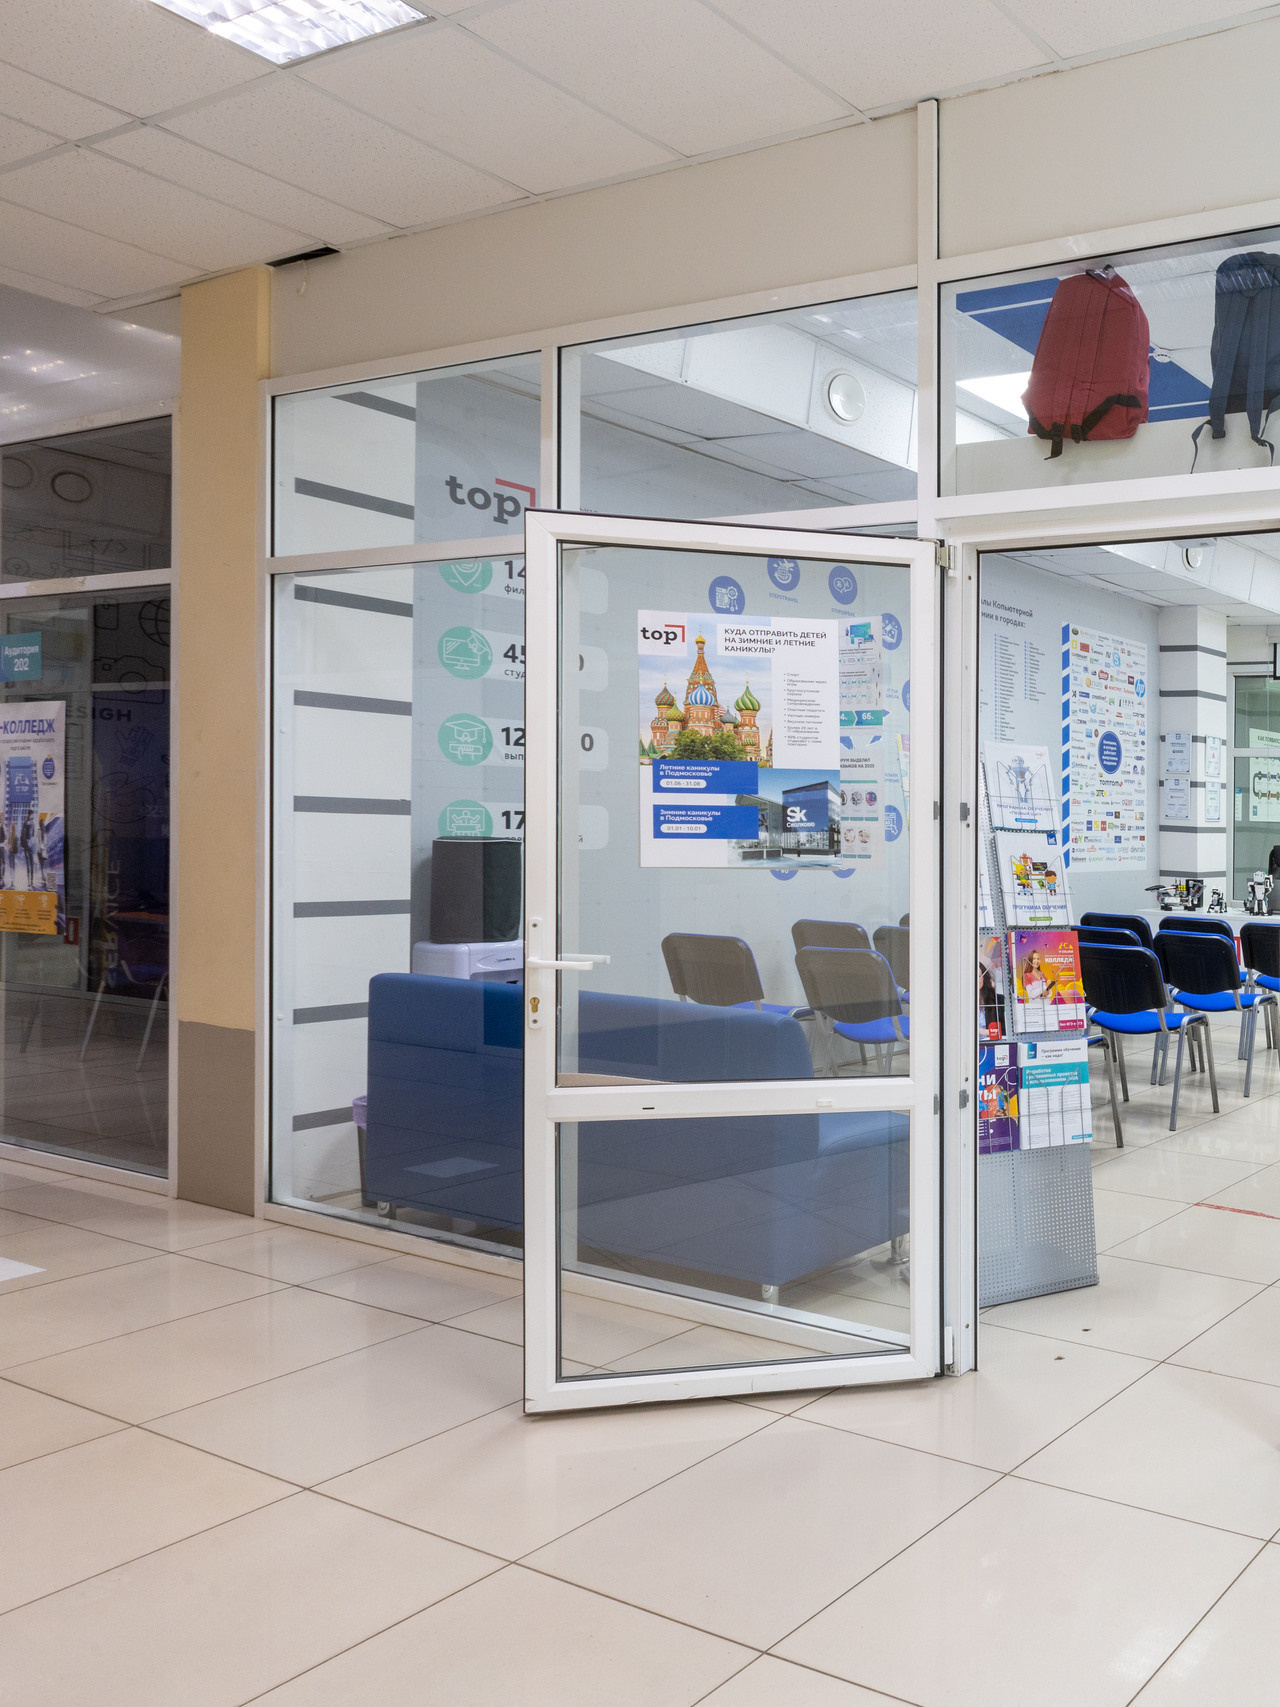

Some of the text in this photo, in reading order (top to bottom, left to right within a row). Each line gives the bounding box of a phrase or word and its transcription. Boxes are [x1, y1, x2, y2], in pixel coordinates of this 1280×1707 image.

[445, 475, 521, 525] top
[640, 626, 678, 645] top
[724, 628, 827, 640] КУДА ОТПРАВИТЬ ДЕТЕЙ
[738, 637, 773, 646] ЗИМНИЕ
[783, 639, 816, 648] ЛЕТНИЕ
[4, 645, 39, 658] Аудитория
[724, 645, 776, 654] КАНИКУЛЫ?
[13, 658, 30, 672] 202
[786, 806, 807, 822] Sk
